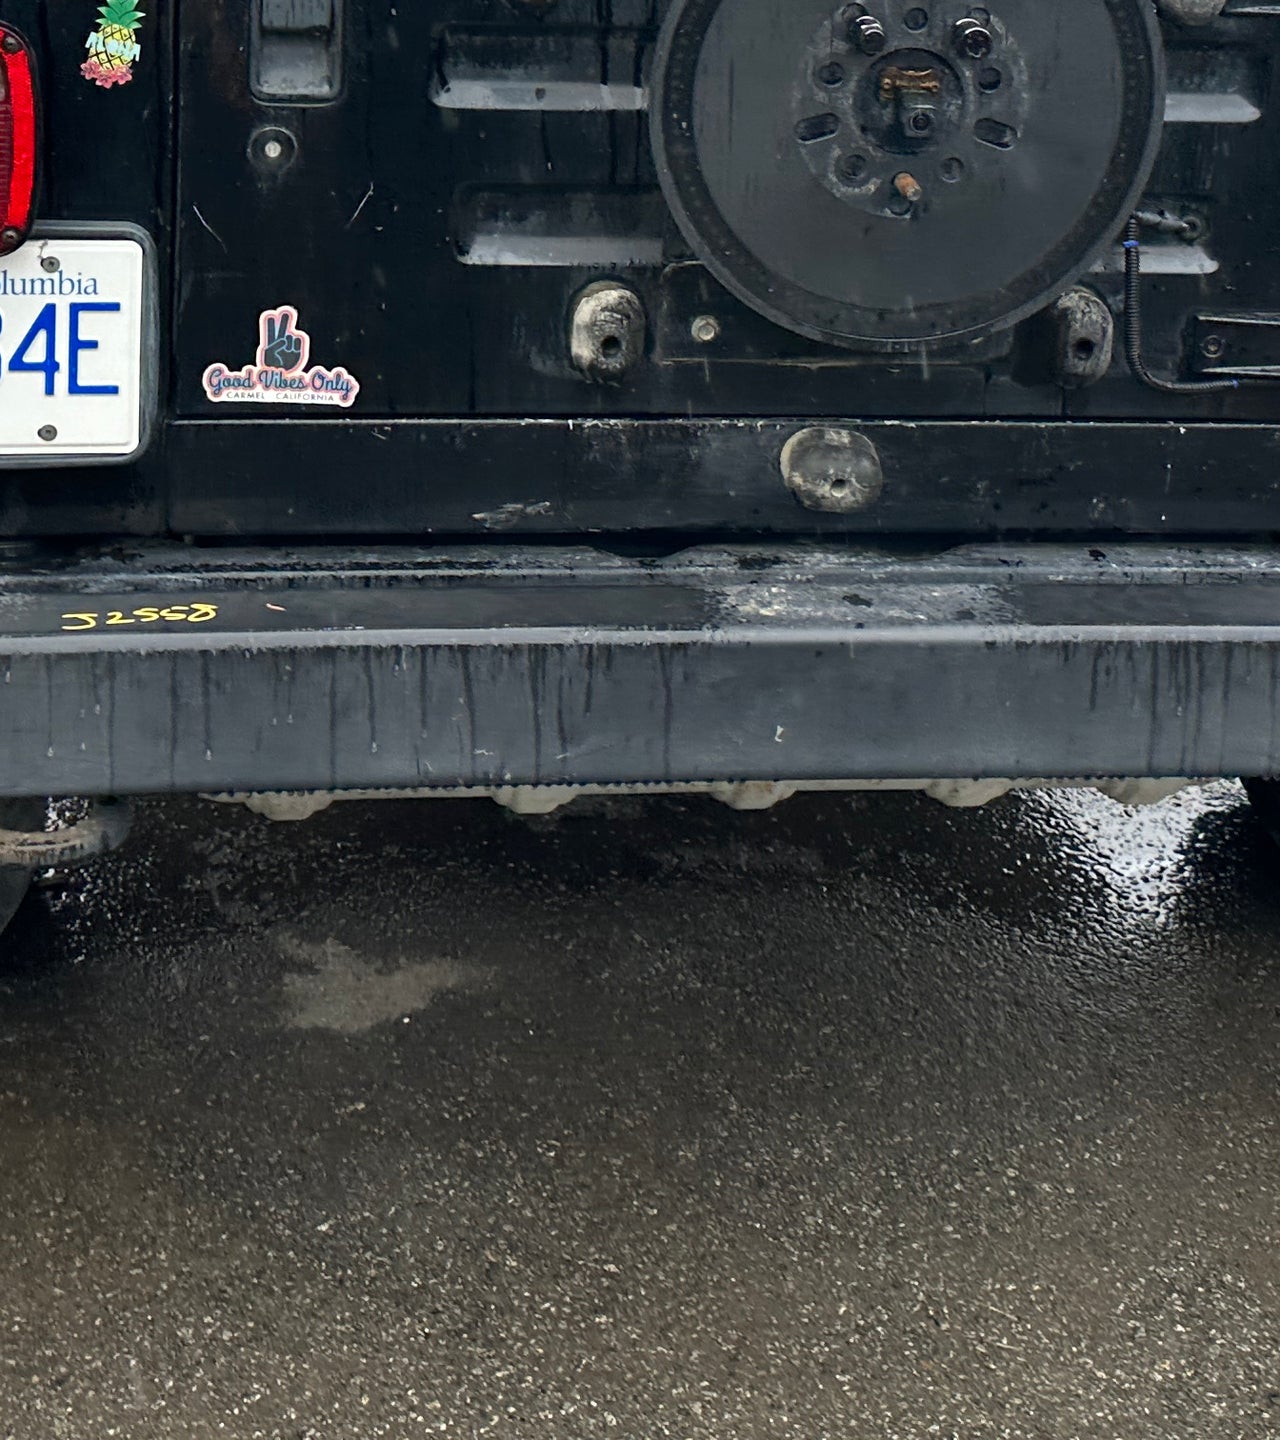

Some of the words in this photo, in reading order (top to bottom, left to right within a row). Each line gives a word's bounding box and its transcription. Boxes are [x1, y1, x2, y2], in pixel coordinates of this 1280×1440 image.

[208, 368, 254, 395] Good
[258, 369, 307, 390] Vibes
[311, 371, 352, 401] Only
[226, 391, 265, 399] CARMEL
[276, 392, 334, 402] CALIFORNIA
[60, 602, 219, 631] J2558
